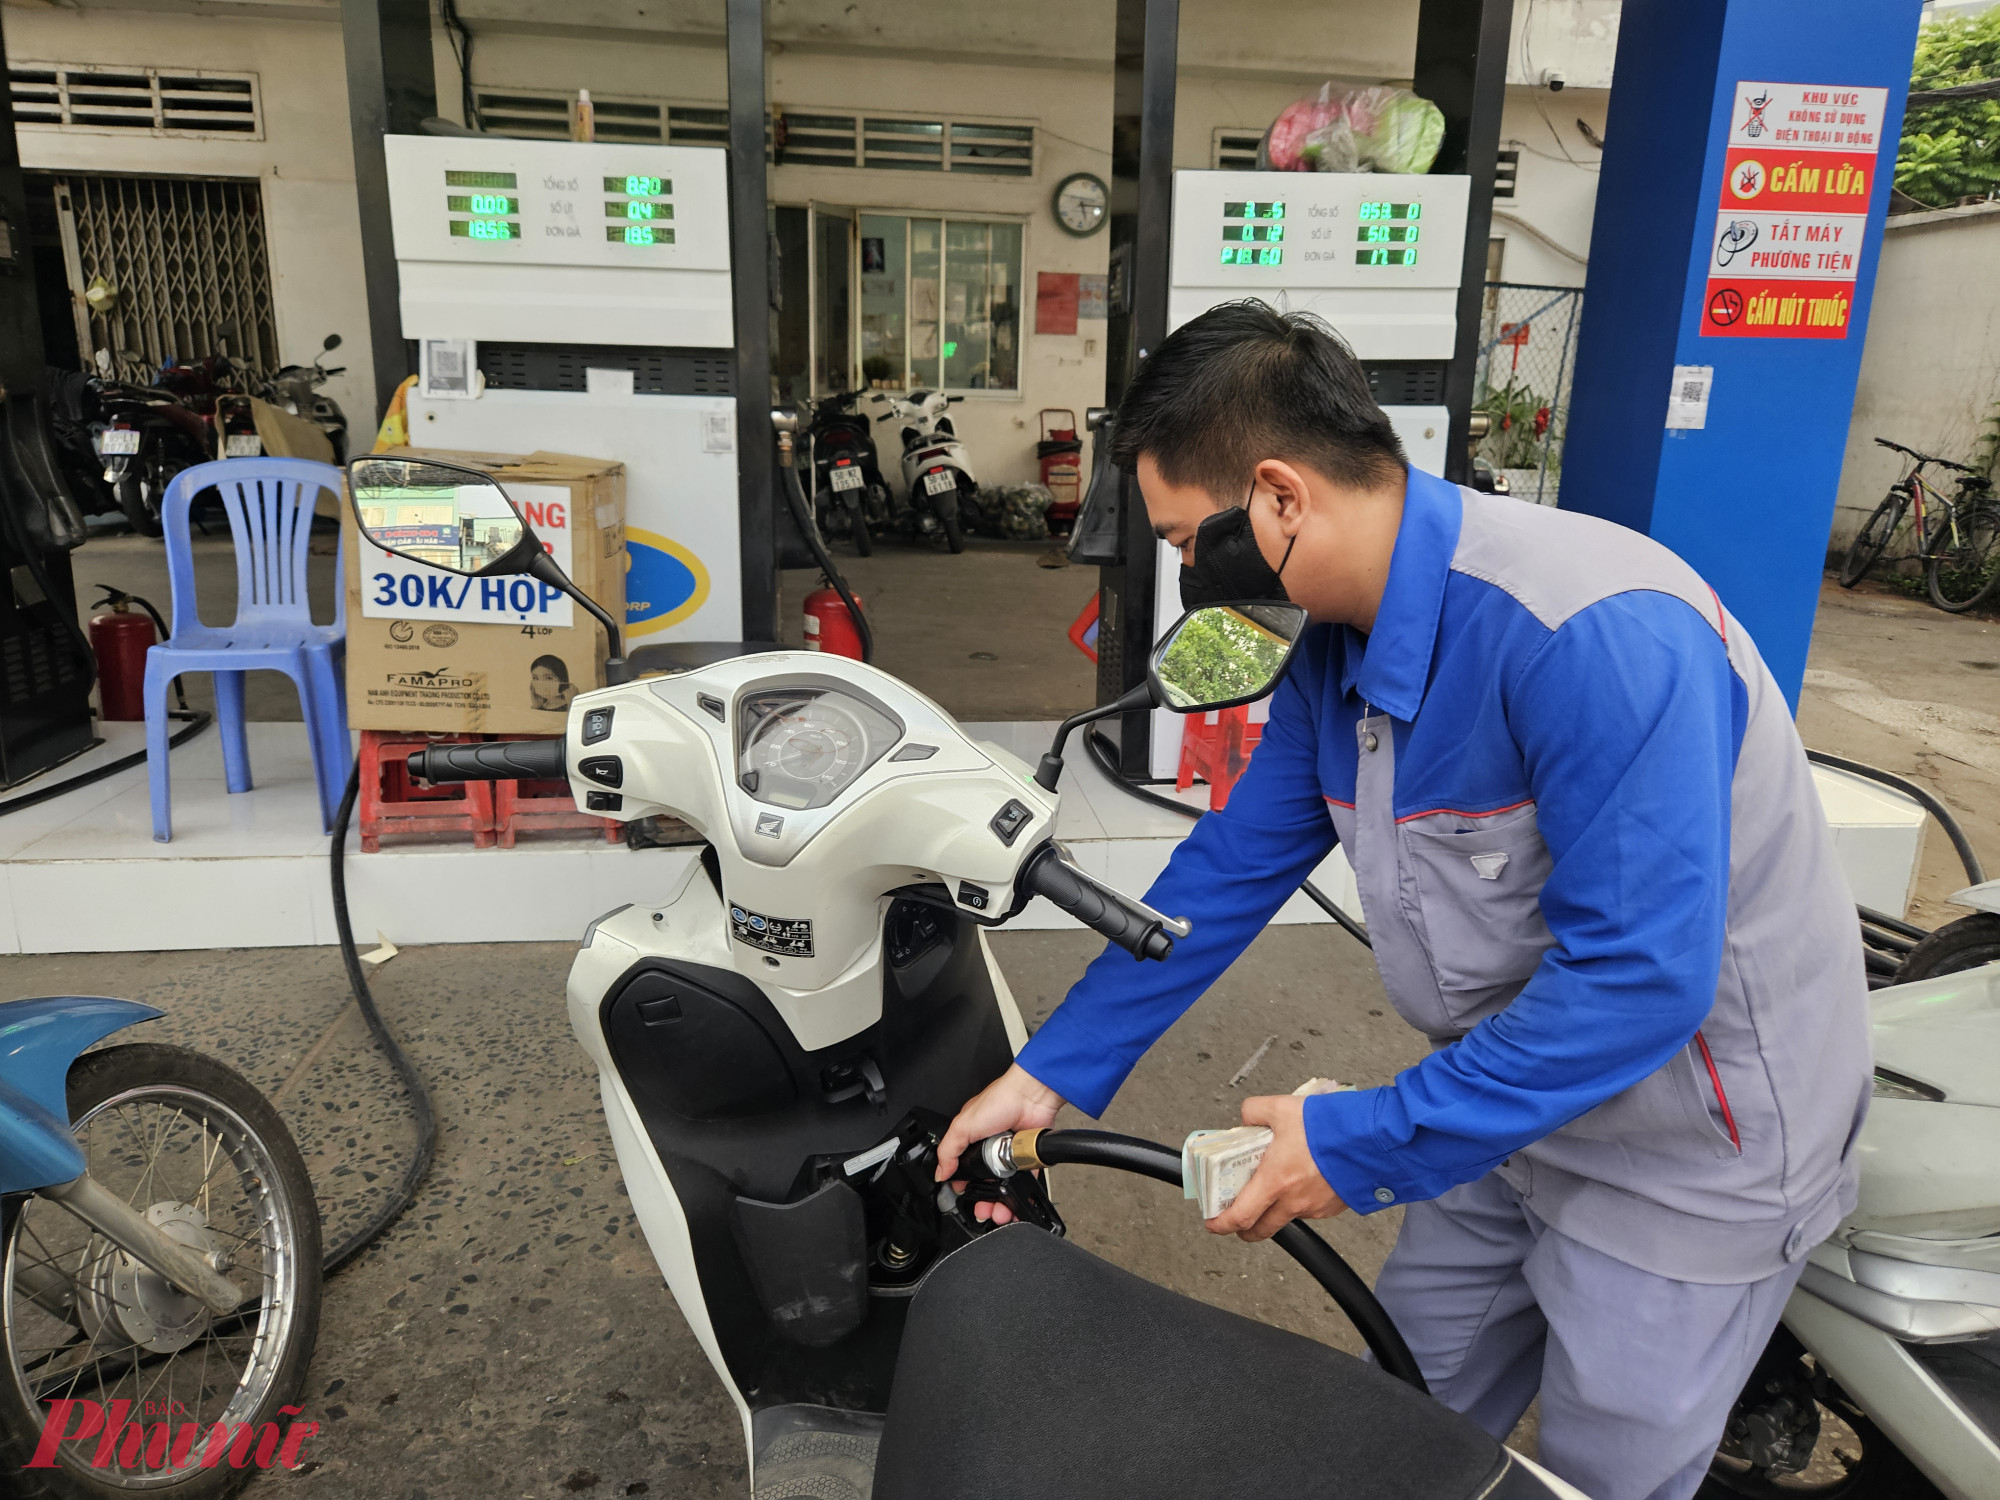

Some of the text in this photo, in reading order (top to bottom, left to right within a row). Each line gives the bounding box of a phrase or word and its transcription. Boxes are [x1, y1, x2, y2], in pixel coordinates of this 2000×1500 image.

[1803, 92, 1858, 106] KHU VỰC
[1788, 109, 1866, 126] KHÔNG SỬ DỤNG
[1776, 128, 1799, 144] ĐIỆN
[1803, 130, 1831, 144] THOẠI
[1847, 131, 1873, 146] ĐỘNG
[1770, 160, 1864, 196] CẤM LỬA
[1308, 203, 1328, 218] TỔNG
[1772, 218, 1844, 242] TẮT MÁY
[1751, 250, 1853, 274] PHƯƠNG TIỆN
[1746, 288, 1848, 327] CẤM HÚT THUỐC
